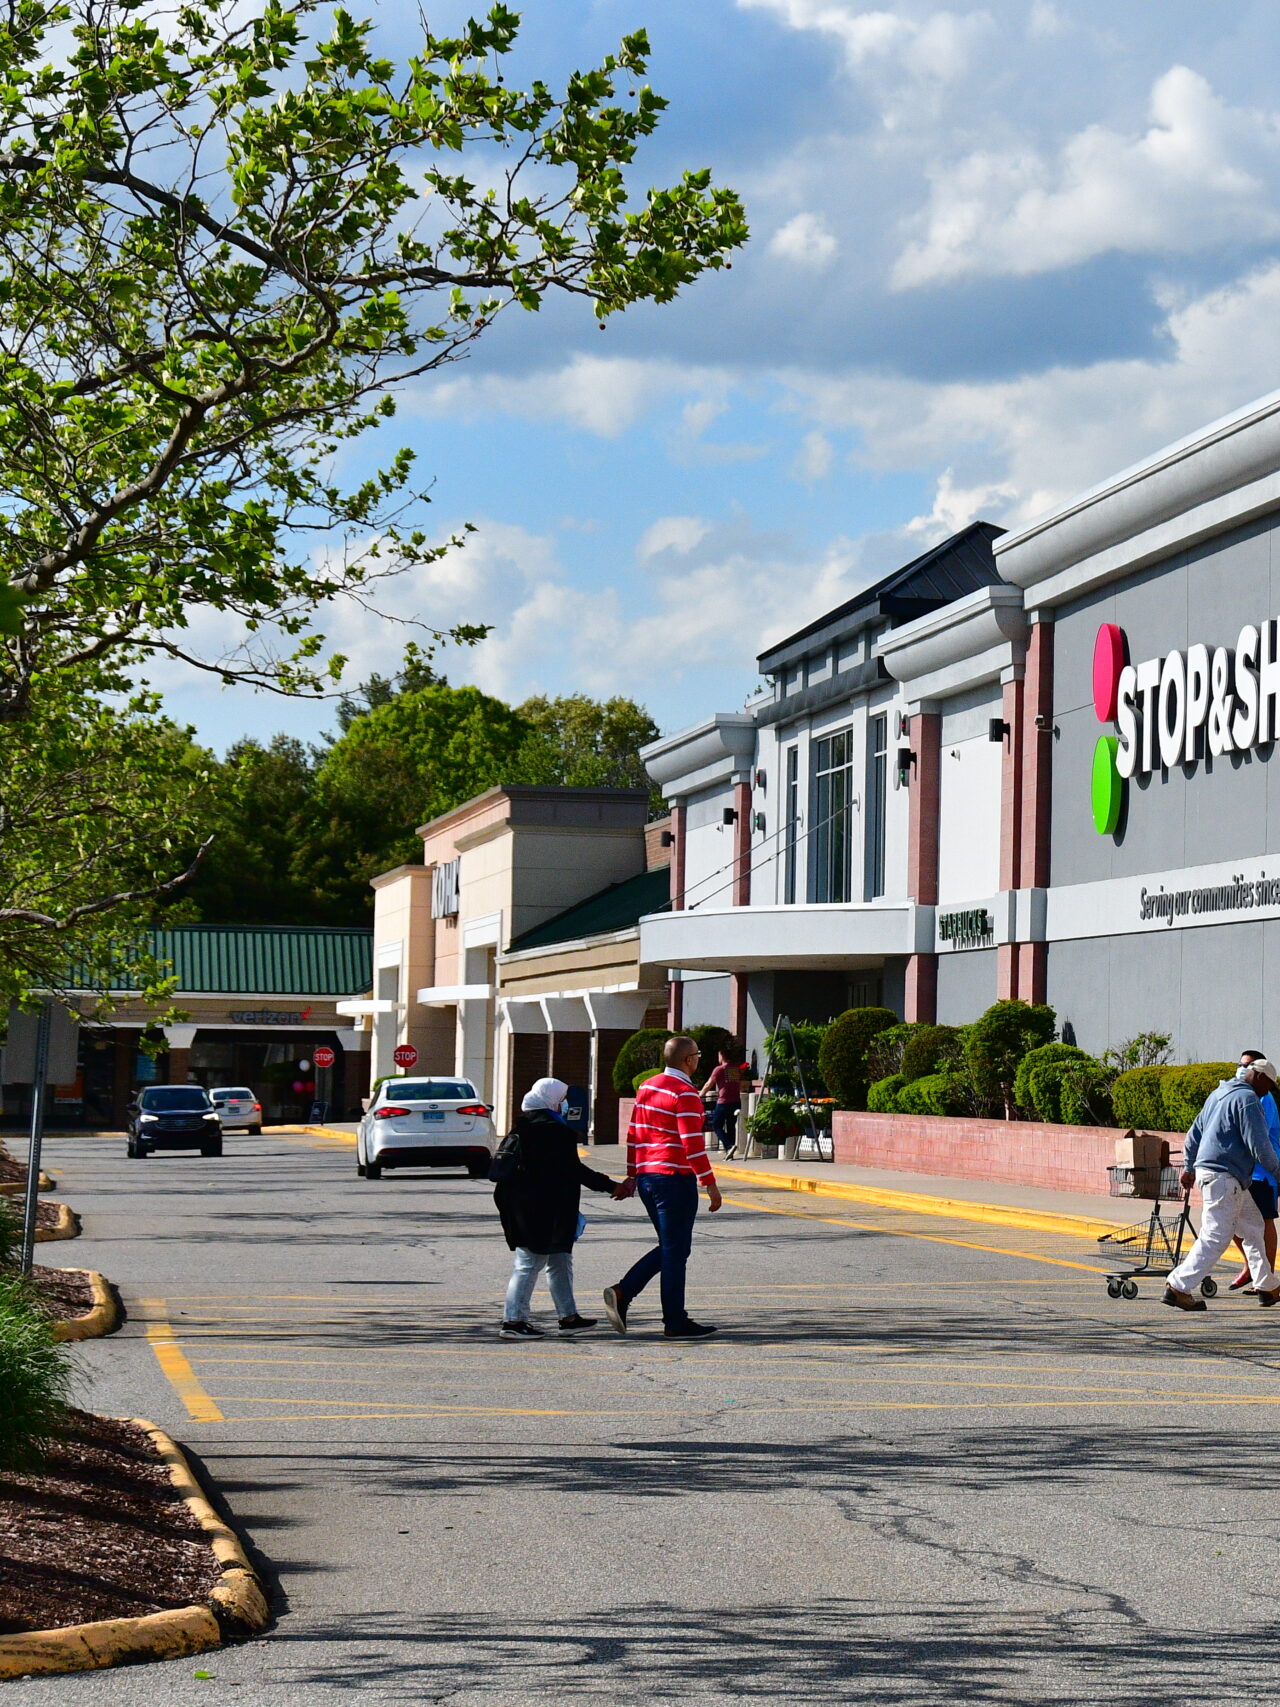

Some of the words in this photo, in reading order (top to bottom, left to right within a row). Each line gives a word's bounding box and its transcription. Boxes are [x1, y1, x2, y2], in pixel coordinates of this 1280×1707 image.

[1139, 886, 1175, 927] Serving
[1174, 889, 1192, 916] our
[1191, 873, 1255, 915] communities
[938, 908, 988, 941] STARBUCKS
[230, 1007, 304, 1026] verizon
[314, 1053, 334, 1061] STOP
[394, 1051, 417, 1061] STOP
